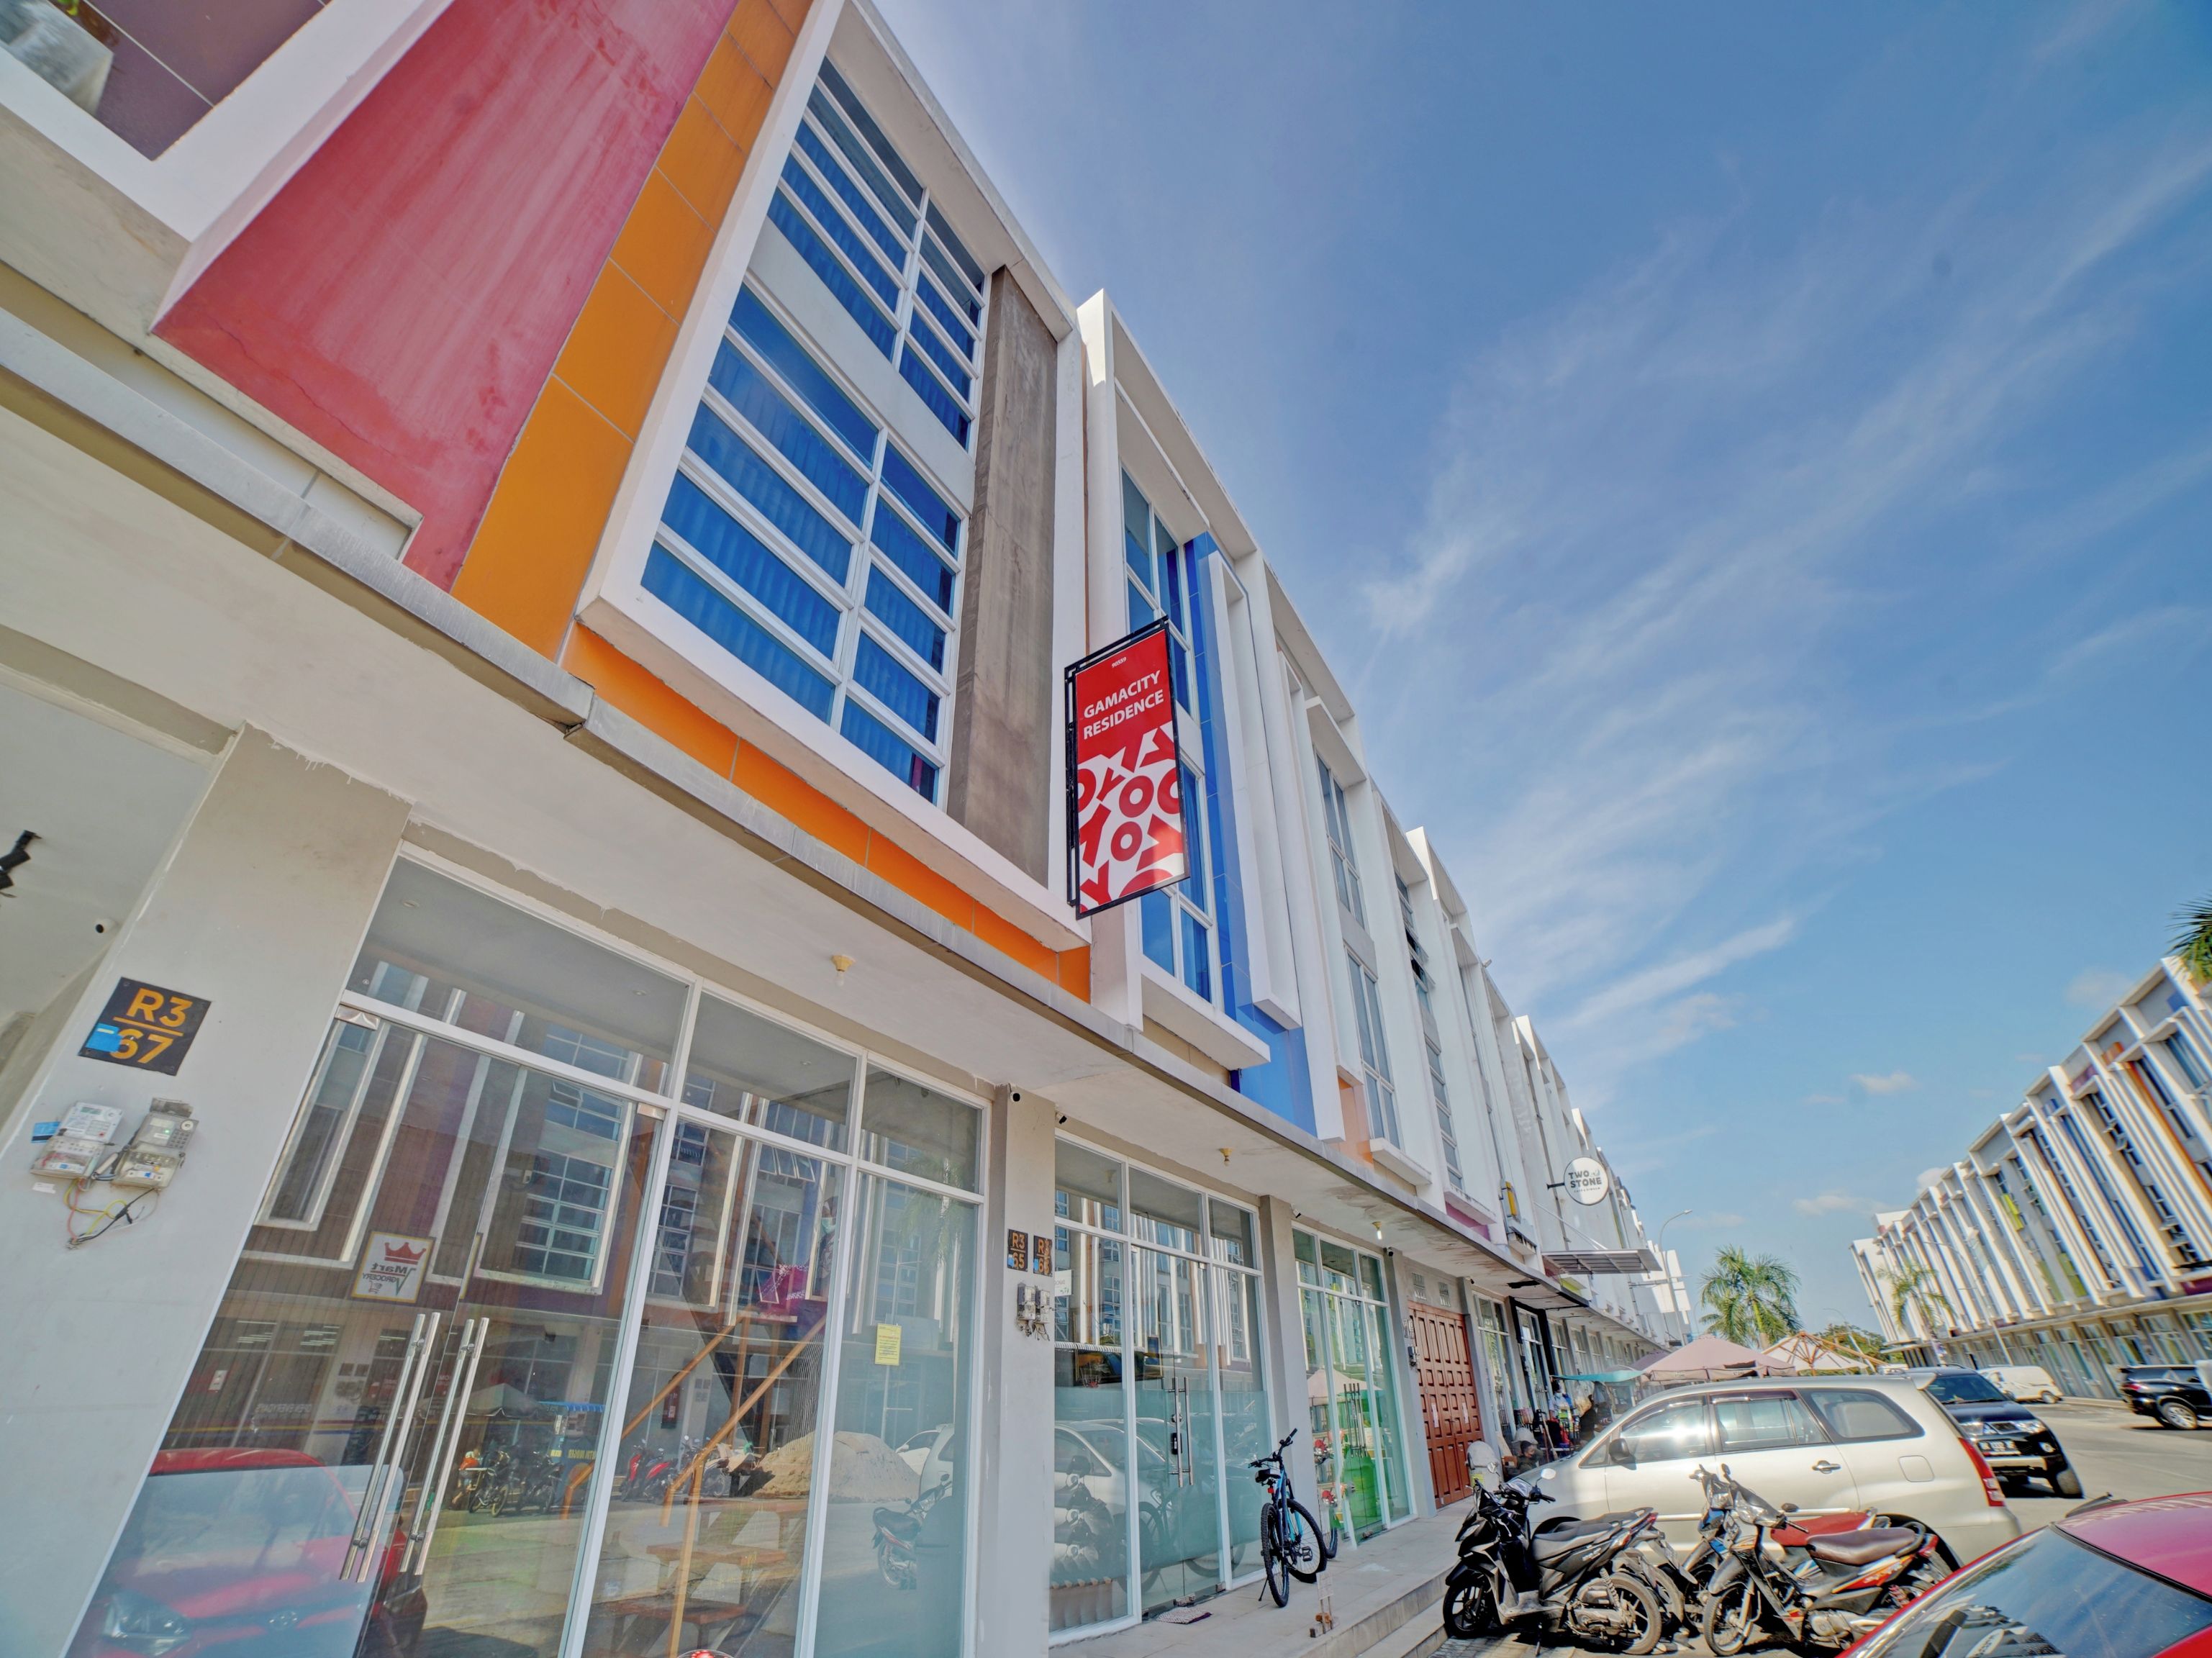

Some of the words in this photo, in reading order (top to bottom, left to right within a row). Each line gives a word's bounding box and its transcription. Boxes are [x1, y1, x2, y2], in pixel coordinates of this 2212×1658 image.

[1084, 670, 1160, 718] GAMACITY
[1084, 689, 1164, 740] RESIDENCE
[127, 988, 193, 1027] R3
[109, 1028, 173, 1064] 67
[1568, 1170, 1590, 1179] TWO
[1570, 1177, 1602, 1188] STONE
[1012, 1232, 1025, 1249] R3
[1012, 1252, 1025, 1268] 65
